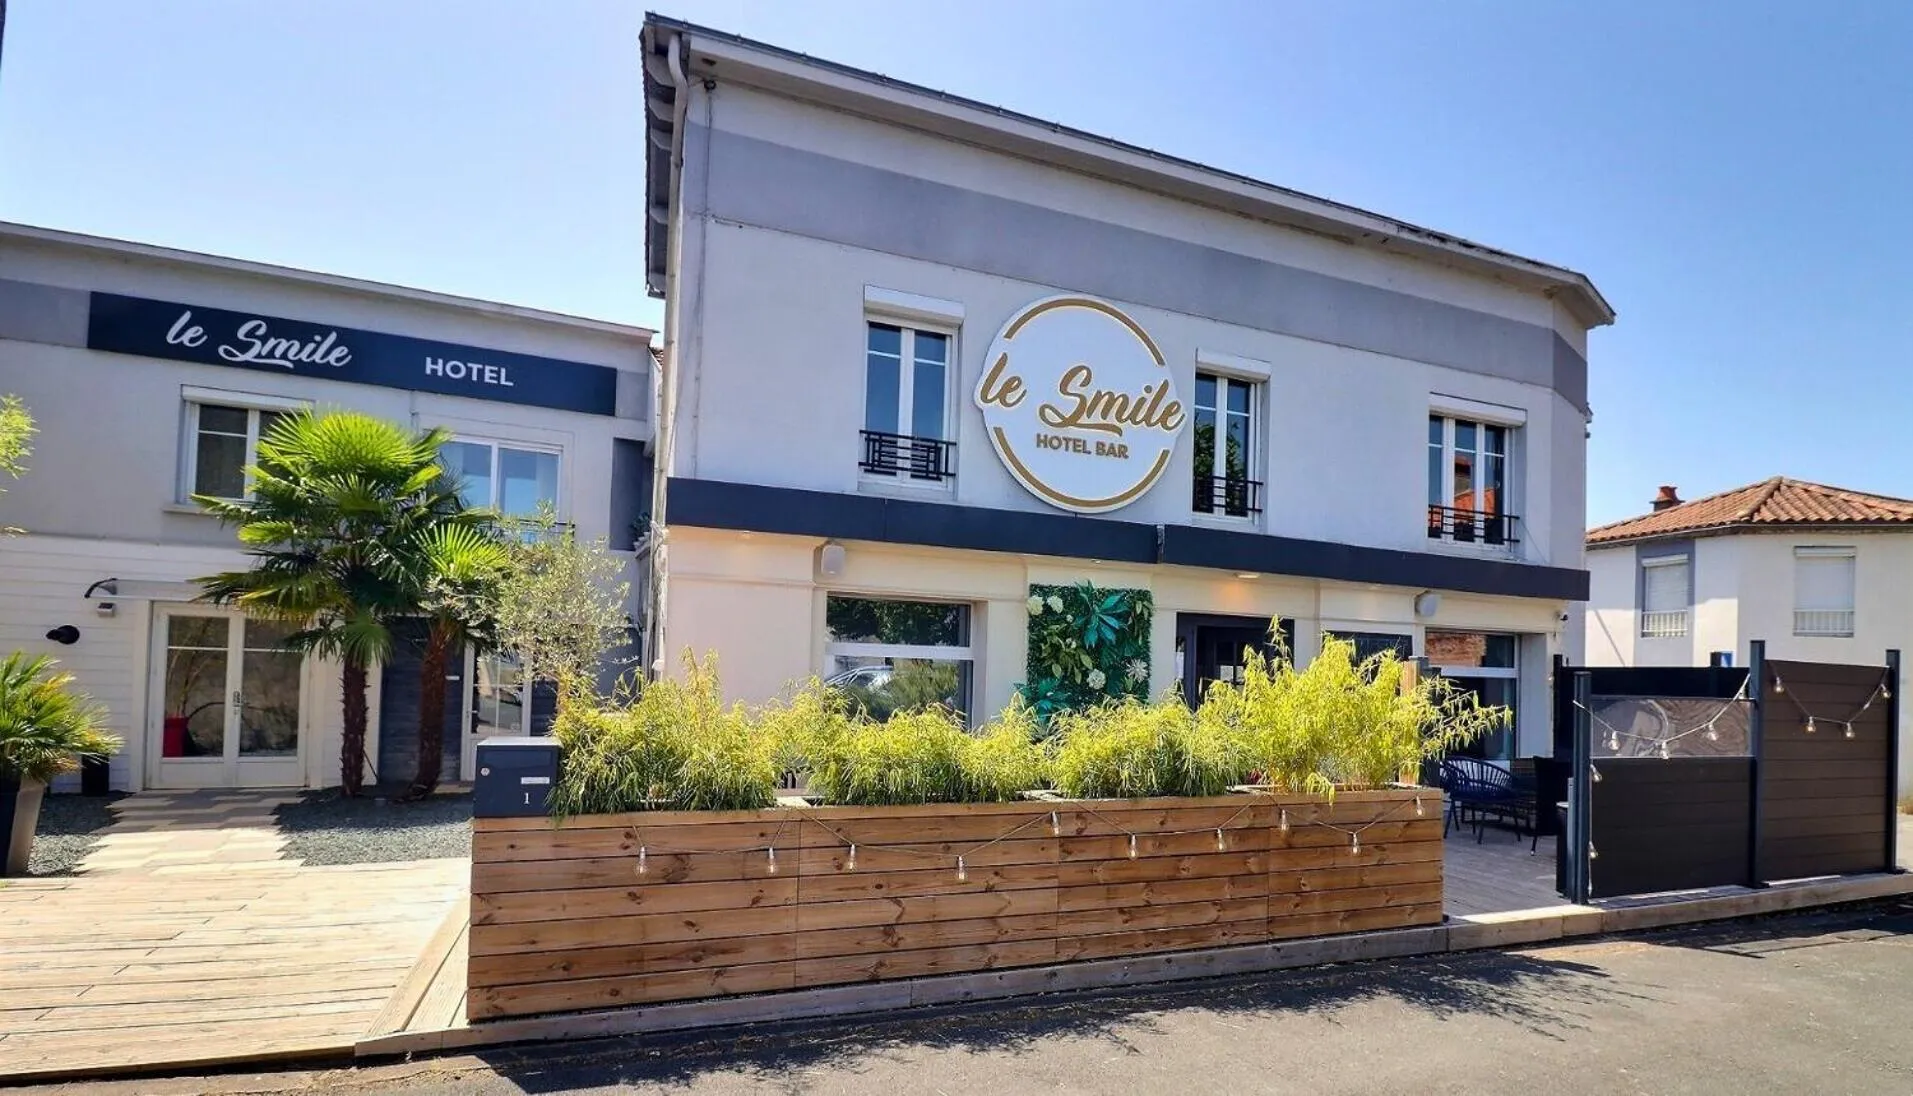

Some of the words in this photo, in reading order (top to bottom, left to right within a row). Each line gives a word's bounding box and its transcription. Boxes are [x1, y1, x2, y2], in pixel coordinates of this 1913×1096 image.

[165, 310, 208, 348] le
[217, 319, 352, 369] Smile
[425, 356, 514, 388] HOTEL
[979, 352, 1028, 408] le
[1038, 365, 1186, 437] Smile
[1036, 433, 1092, 455] HOTEL
[1095, 440, 1129, 459] BAR
